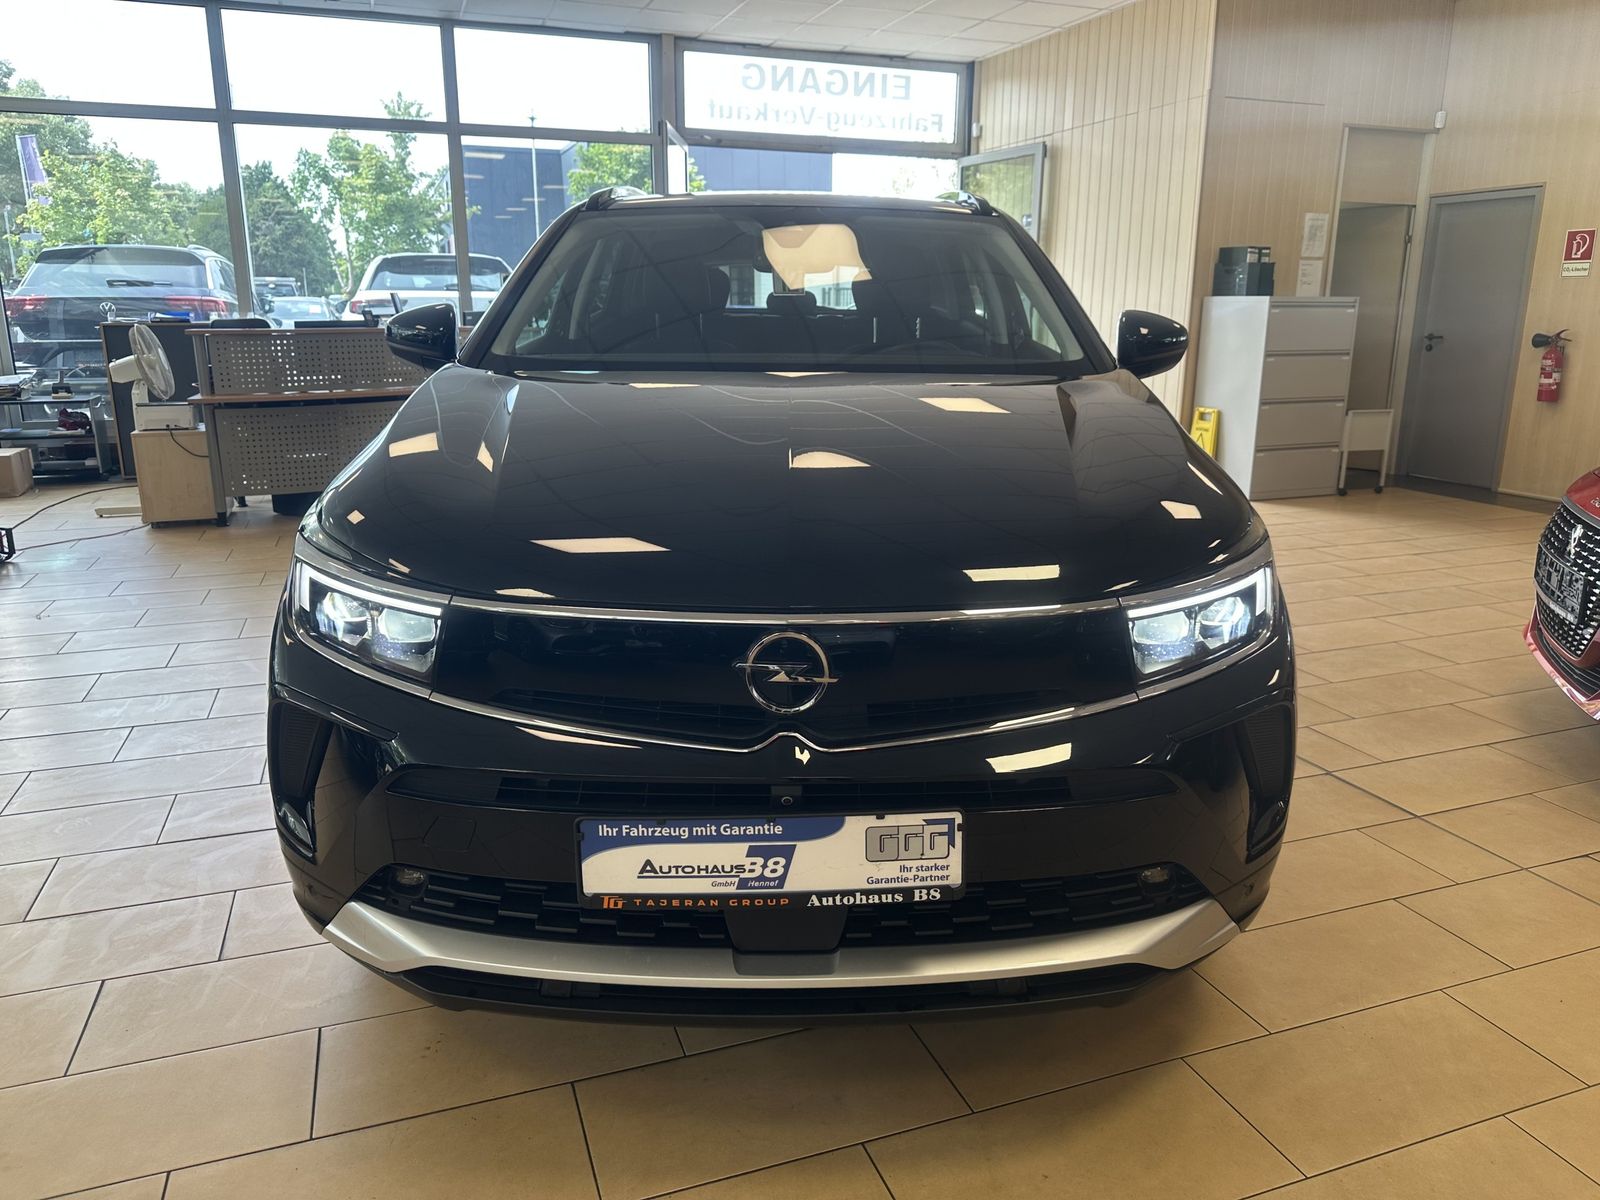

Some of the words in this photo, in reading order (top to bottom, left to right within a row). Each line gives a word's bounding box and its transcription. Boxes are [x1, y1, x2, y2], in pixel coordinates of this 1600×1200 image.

[598, 825, 619, 837] Ihr
[622, 825, 689, 839] Fahrzeug
[692, 824, 717, 836] mit
[720, 822, 783, 836] Garantie
[899, 864, 914, 874] Ihr
[915, 863, 950, 873] starker
[711, 880, 736, 888] GmbH
[748, 880, 779, 888] Hennef
[866, 873, 951, 885] Garantie-Partner
[633, 898, 719, 907] TAJERAN
[729, 898, 789, 906] GROUP
[807, 892, 904, 907] Autohaus
[913, 888, 941, 901] B8
